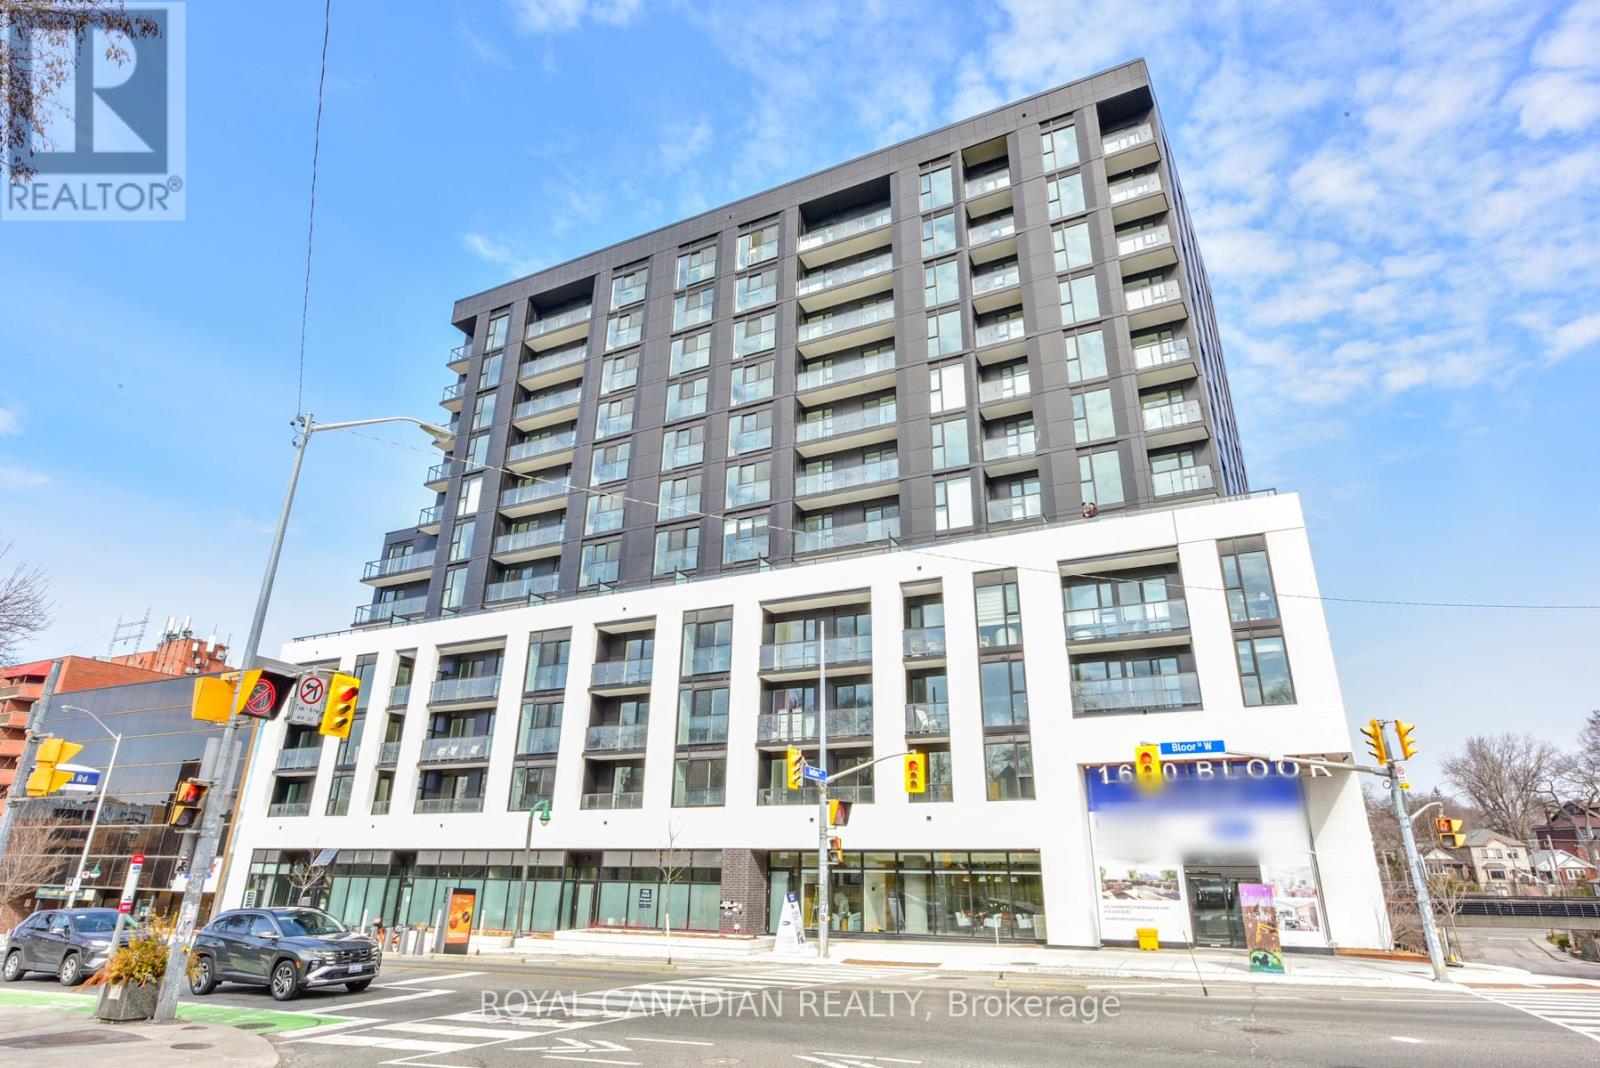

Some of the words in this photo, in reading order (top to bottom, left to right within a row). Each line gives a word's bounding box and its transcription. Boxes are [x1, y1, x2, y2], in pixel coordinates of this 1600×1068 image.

[1171, 742, 1197, 752] Bloor
[1203, 741, 1212, 751] W
[1098, 762, 1177, 785] 160
[1195, 756, 1333, 779] BLOOR
[76, 774, 89, 783] Rd
